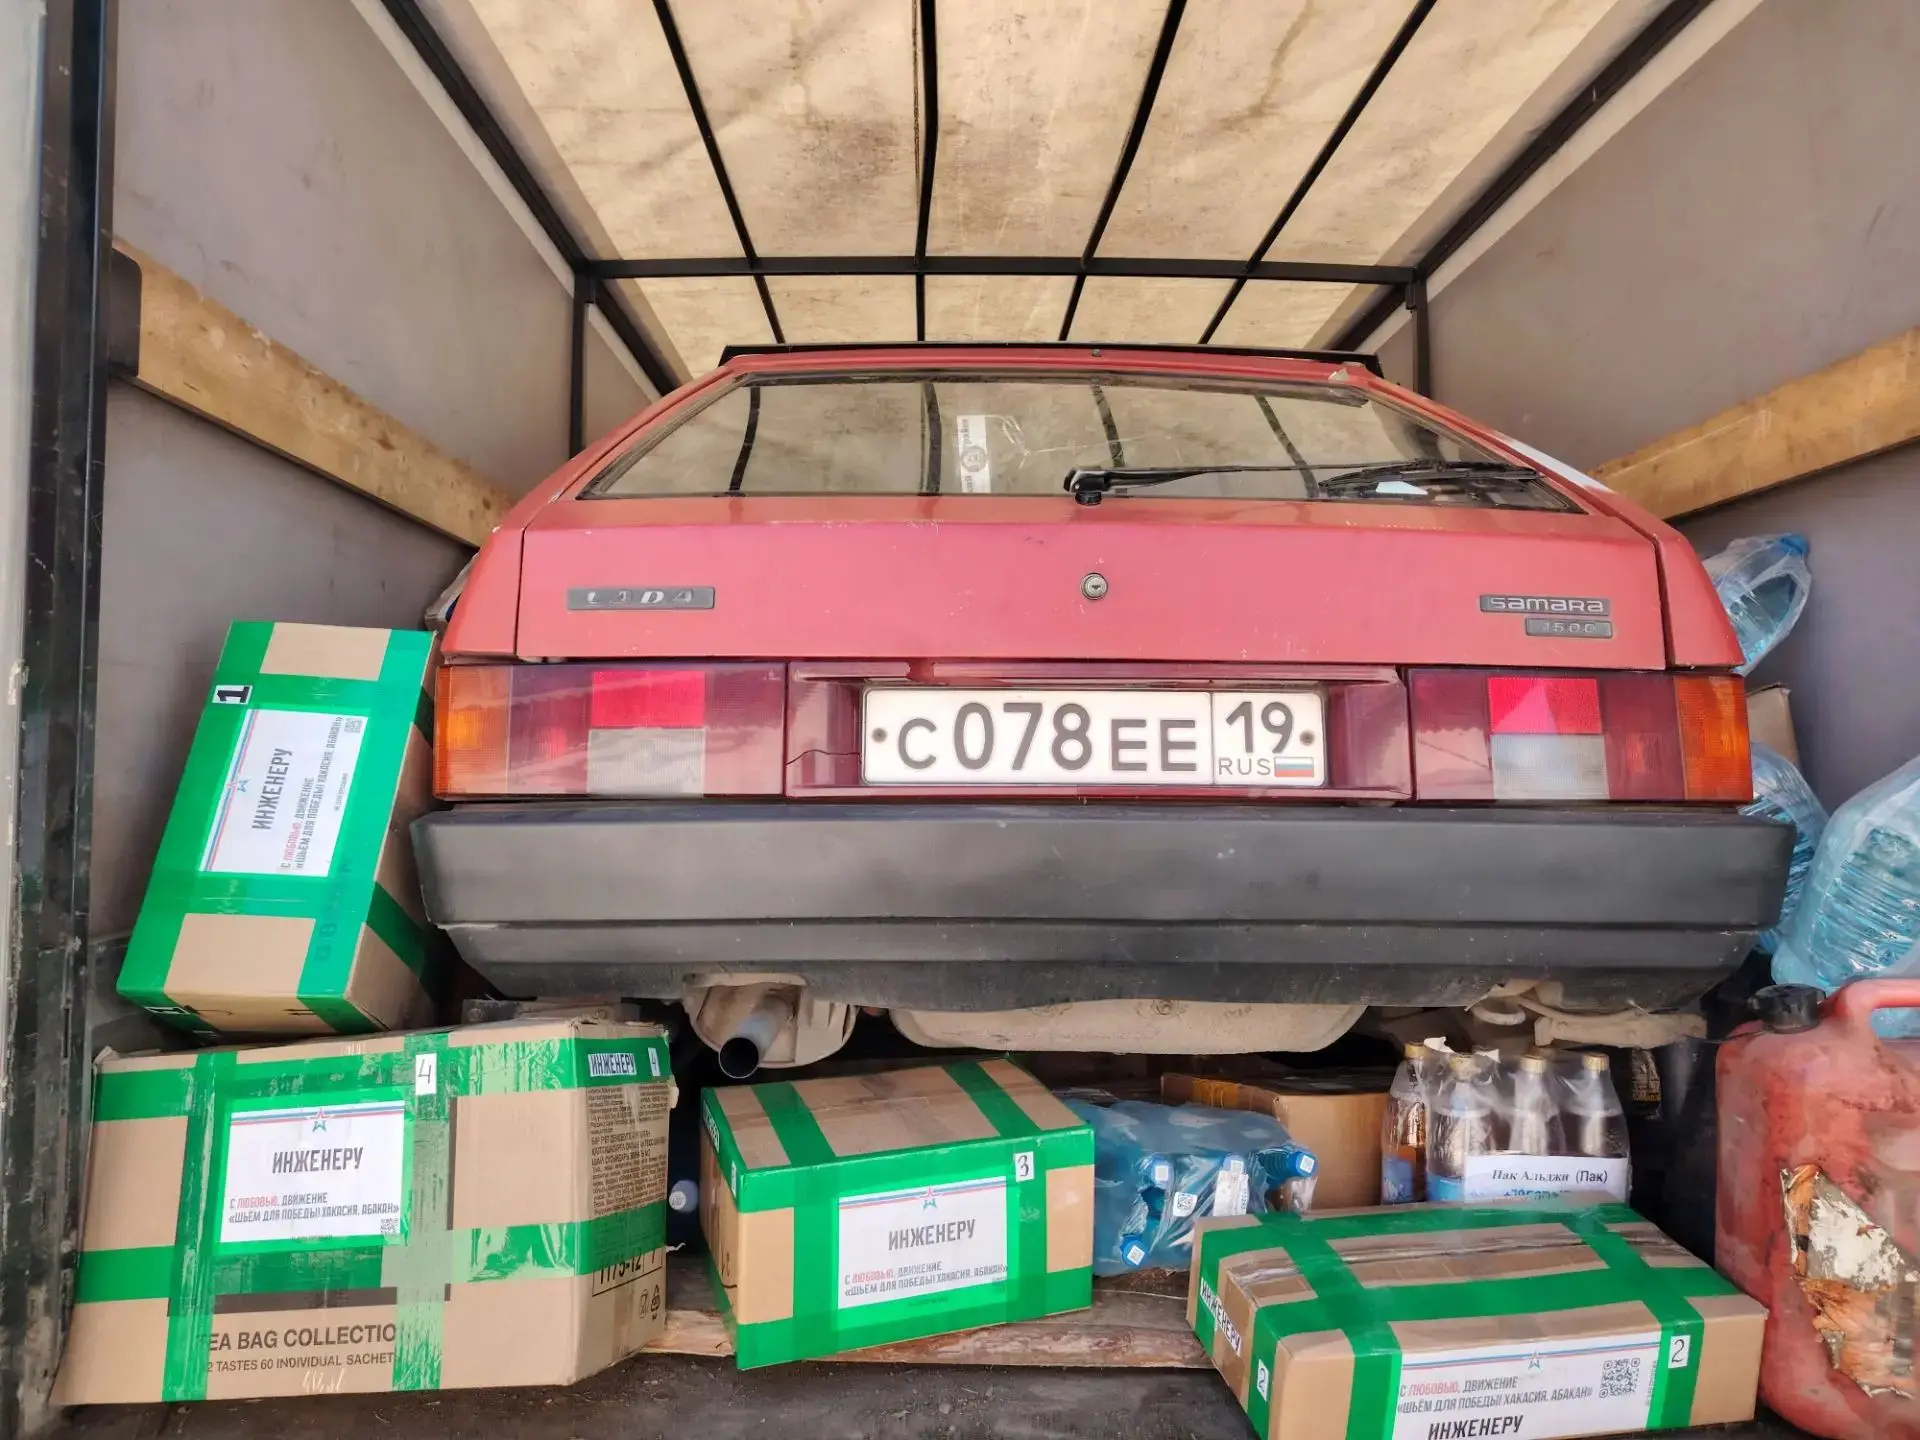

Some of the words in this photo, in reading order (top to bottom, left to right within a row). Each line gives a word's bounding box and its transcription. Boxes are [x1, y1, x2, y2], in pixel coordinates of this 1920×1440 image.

[584, 590, 694, 607] LADA
[1543, 622, 1596, 633] 1500
[217, 686, 250, 704] 1
[1225, 700, 1294, 754] 19
[1218, 757, 1271, 775] RUS
[252, 748, 293, 830] ИНЖЕНЕРУ
[294, 777, 315, 819] ДВИЖЕНИЕ
[301, 820, 315, 837] ДЛЯ
[418, 1058, 432, 1085] 4
[590, 1052, 636, 1076] ИНЖЕНЕРУ
[272, 1146, 364, 1174] ИНЖЕНЕРУ
[1017, 1154, 1030, 1177] 3
[1491, 1169, 1518, 1181] Пак
[1521, 1169, 1570, 1183] Альджи
[1575, 1169, 1608, 1184] (Пак)
[229, 1199, 236, 1209] С
[281, 1192, 328, 1206] ДВИЖЕНИЕ
[262, 1208, 280, 1222] ДЛЯ
[281, 1206, 321, 1221] ПОБЕДЫ!
[361, 1202, 400, 1216] АБАКАН»
[888, 1219, 976, 1251] ИНЖЕНЕРУ
[844, 1274, 851, 1285] С
[897, 1261, 942, 1278] ДВИЖЕНИЕ
[879, 1280, 897, 1292] ДЛЯ
[898, 1275, 935, 1289] ПОБЕДЫ!
[973, 1264, 1008, 1278] АБАКАН»
[1202, 1284, 1241, 1352] ИНЖЕНЕРУ
[197, 1332, 232, 1351] EA
[237, 1329, 278, 1350] BAG
[283, 1323, 397, 1347] COLLECTIO
[216, 1358, 258, 1373] TASTES
[260, 1358, 274, 1369] 60
[276, 1355, 342, 1369] INDIVIDUAL
[346, 1351, 396, 1366] SACHET
[1671, 1339, 1685, 1364] 2
[1259, 1367, 1266, 1393] 2
[1400, 1384, 1408, 1397] С
[1462, 1376, 1518, 1394] ДВИЖЕНИЕ
[1433, 1398, 1457, 1413] ДЛЯ
[1458, 1394, 1503, 1411] ПОБЕДЫ!
[1550, 1386, 1593, 1401] АБАКАН»
[1427, 1415, 1524, 1440] ИНЖЕНЕРУ
